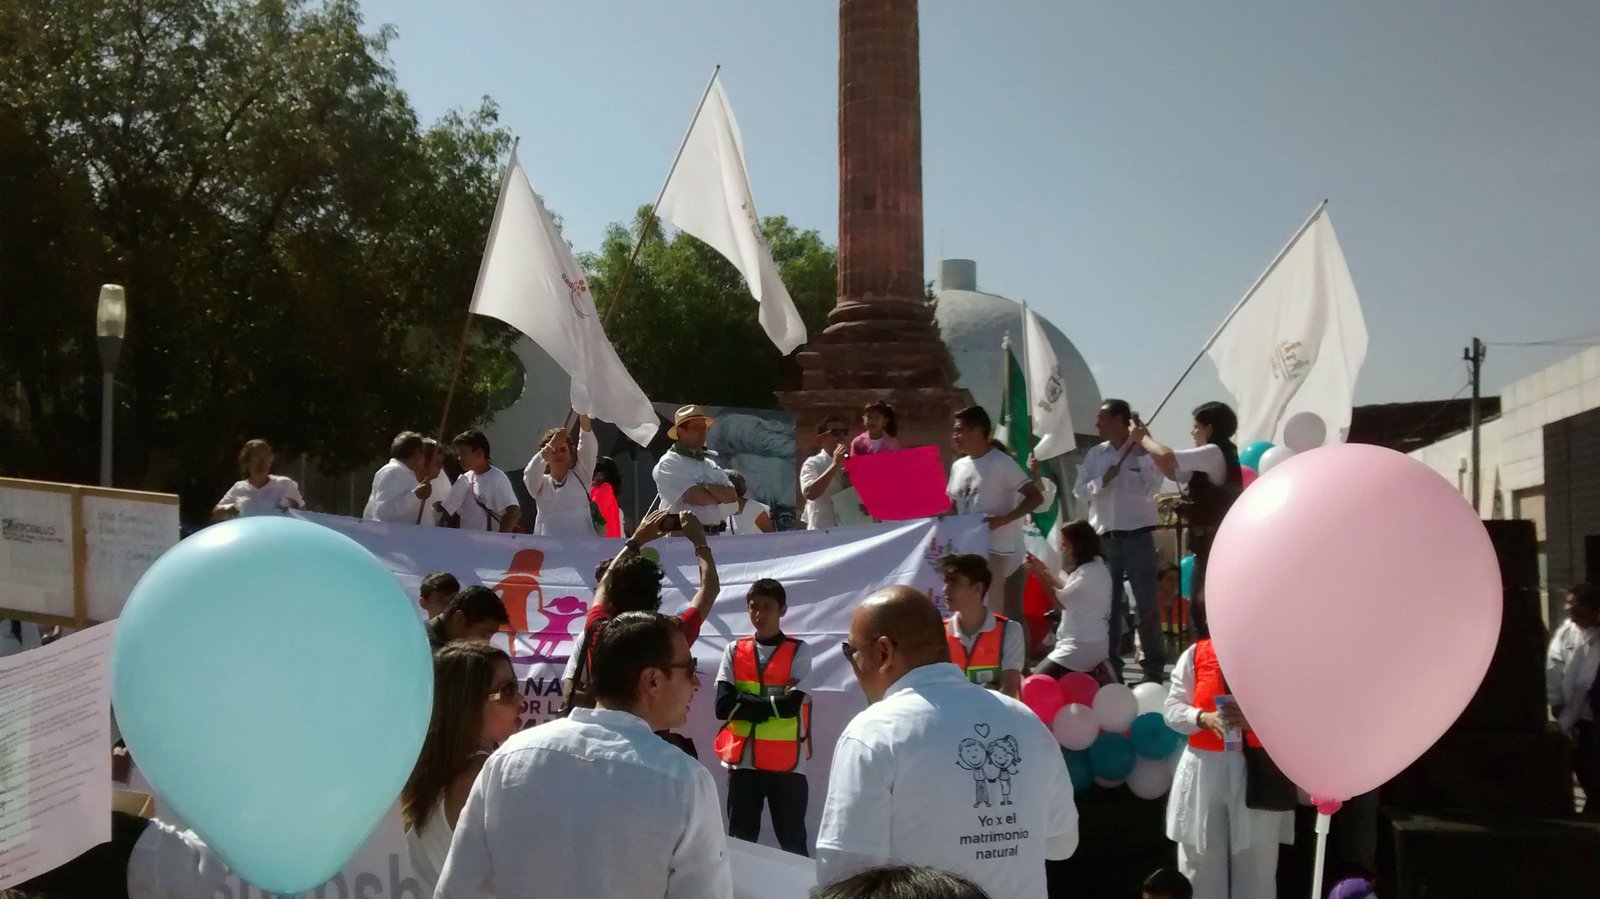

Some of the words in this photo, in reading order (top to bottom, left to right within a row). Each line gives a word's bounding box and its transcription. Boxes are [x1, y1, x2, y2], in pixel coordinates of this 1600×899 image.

[519, 700, 541, 715] OR
[978, 815, 993, 827] Yo
[996, 816, 1003, 825] x
[1006, 813, 1016, 824] el
[960, 828, 1029, 845] matrimonio
[976, 845, 1018, 859] natural
